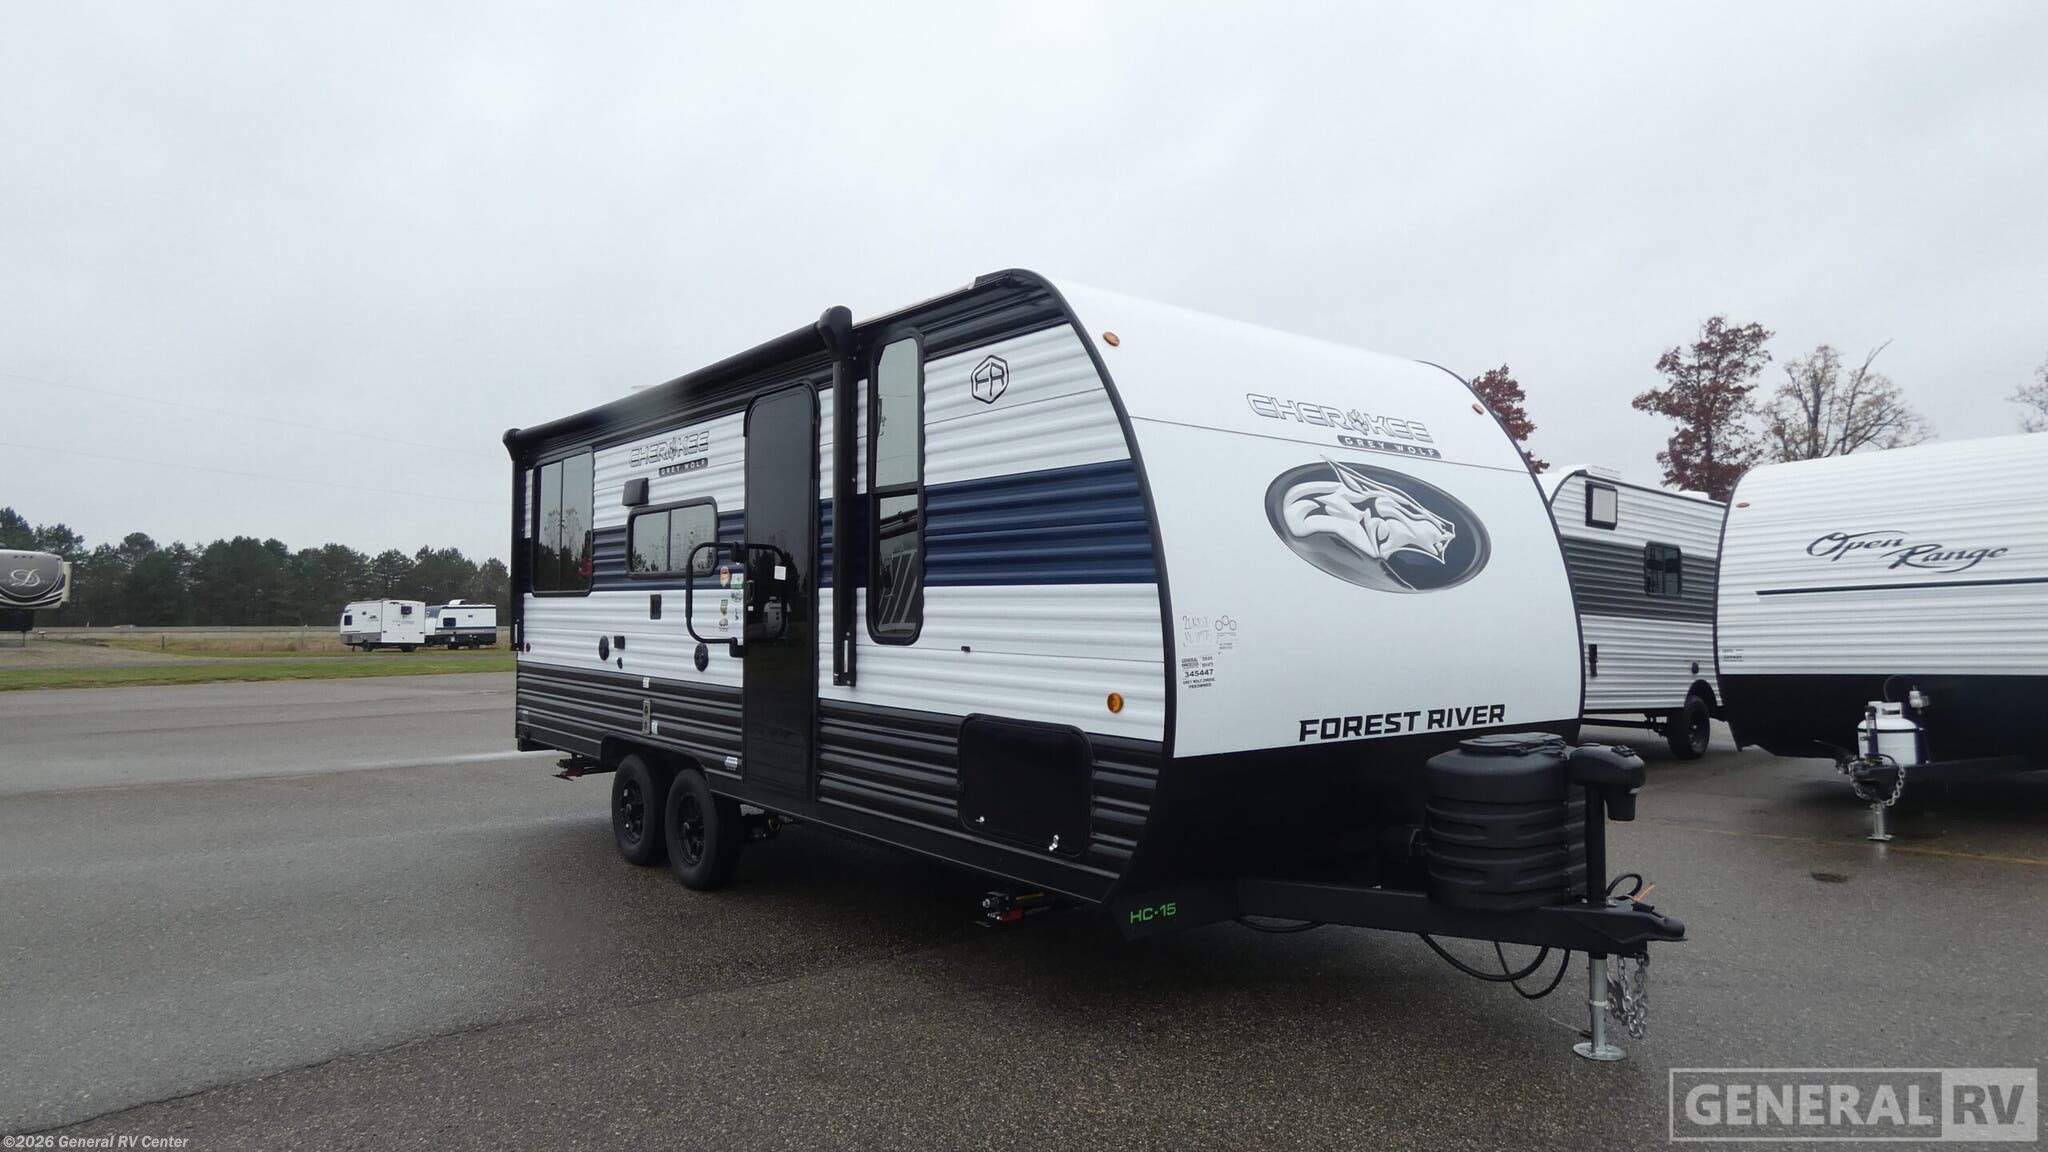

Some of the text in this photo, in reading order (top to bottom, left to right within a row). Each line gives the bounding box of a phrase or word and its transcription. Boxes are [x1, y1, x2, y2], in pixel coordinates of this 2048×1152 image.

[1247, 393, 1434, 443] CHEROKEE
[1345, 437, 1435, 457] GREY WOLF
[661, 460, 705, 475] GREY WOLF
[1806, 530, 1909, 561] Open
[1878, 543, 2009, 573] Range
[1184, 669, 1214, 677] 345447
[1299, 704, 1505, 742] FOREST RIVER
